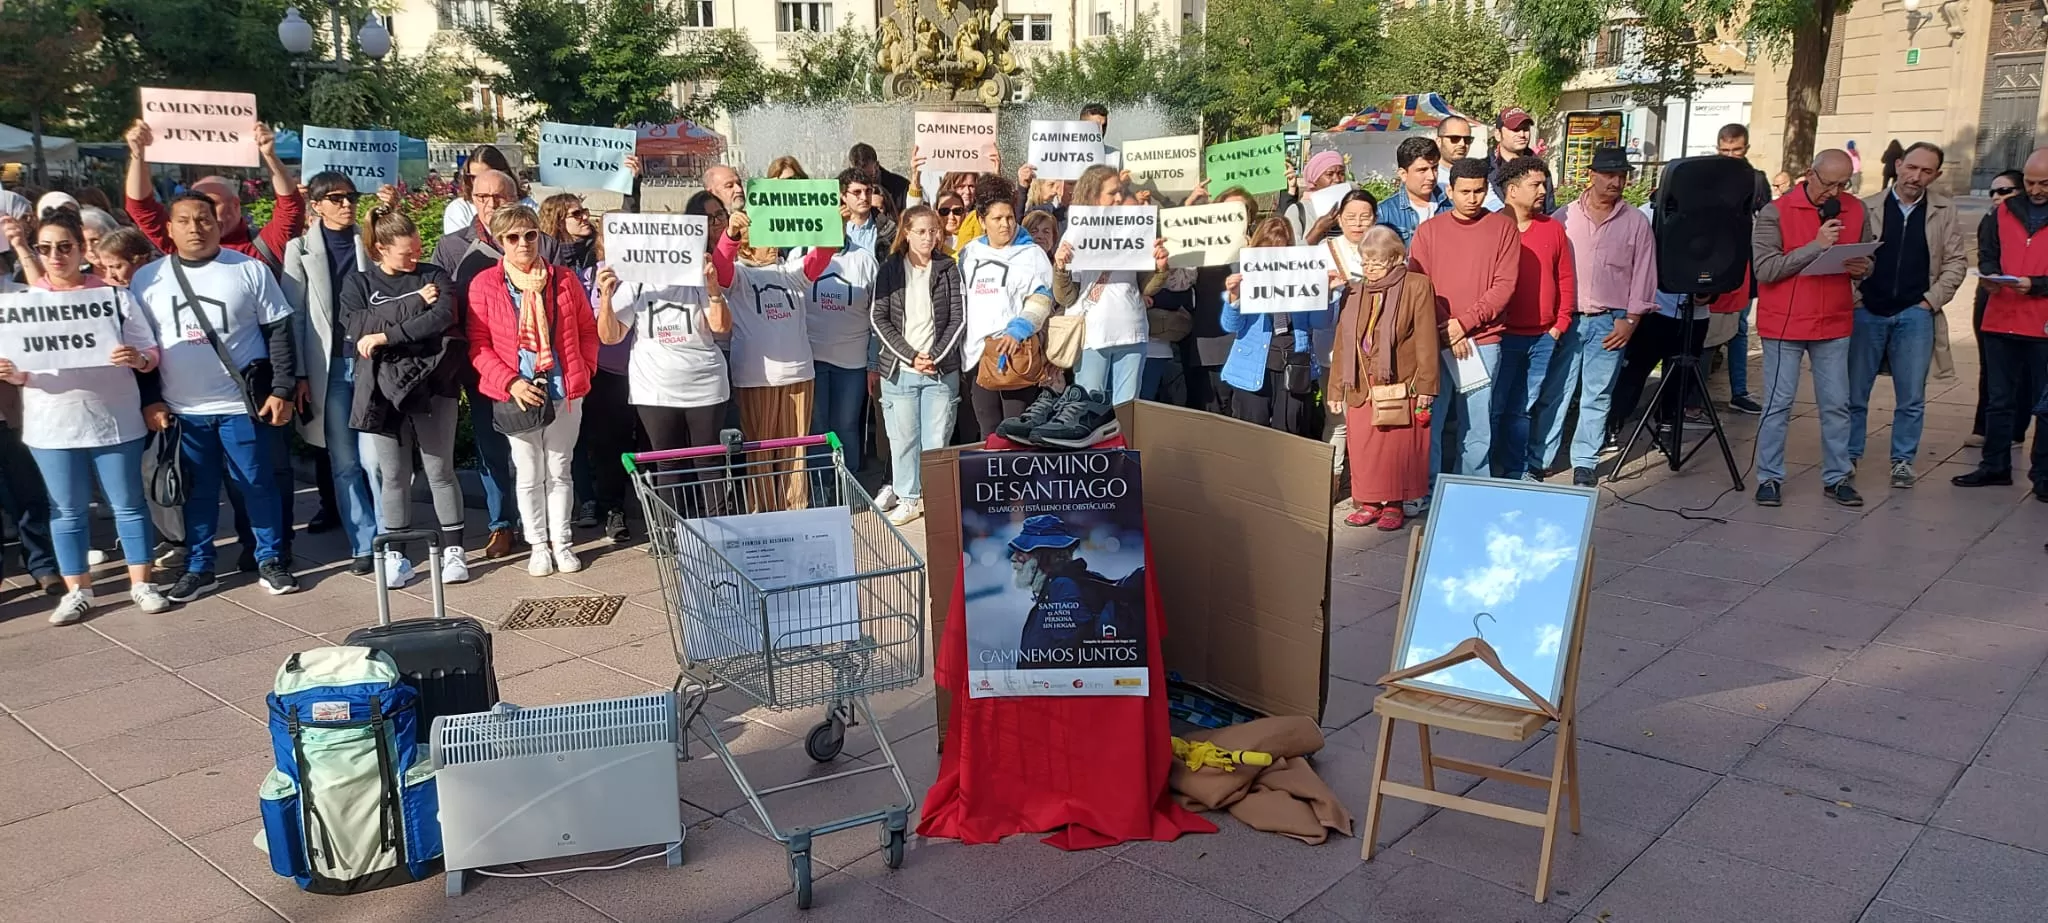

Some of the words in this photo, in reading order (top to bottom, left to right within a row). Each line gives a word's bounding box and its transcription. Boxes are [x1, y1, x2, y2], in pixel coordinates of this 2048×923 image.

[146, 101, 253, 116] CAMINEMOS
[164, 128, 239, 143] JUNTAS
[917, 123, 994, 135] CAMINEMOS
[542, 133, 633, 151] CAMINEMOS
[1032, 132, 1102, 143] CAMINEMOS
[306, 138, 398, 153] CAMINEMOS
[932, 149, 979, 160] JUNTOS
[1040, 152, 1094, 163] JUNTAS
[1126, 148, 1197, 162] CAMINEMOS
[1208, 143, 1283, 163] CAMINEMOS
[553, 157, 620, 172] JUNTOS
[1139, 168, 1184, 180] JUNTOS
[1223, 166, 1271, 181] JUNTOS
[748, 192, 838, 206] CAMINEMOS
[769, 218, 823, 232] JUNTOS
[1070, 215, 1154, 226] CAMINEMOS
[1163, 211, 1245, 228] CAMINEMOS
[608, 222, 704, 237] CAMINEMOS
[1078, 238, 1145, 250] JUNTAS
[1179, 234, 1232, 248] JUNTAS
[622, 250, 692, 264] JUNTOS
[1243, 259, 1326, 272] CAMINEMOS
[1249, 284, 1320, 299] JUNTAS
[821, 304, 845, 312] HOGAR
[767, 312, 791, 320] HOGAR
[24, 333, 96, 352] JUNTOS
[987, 457, 1008, 477] EL
[1012, 453, 1109, 476] CAMINO
[976, 482, 1005, 502] DE
[1009, 478, 1128, 501] SANTIAGO
[996, 505, 1019, 513] LARGO
[1025, 503, 1040, 512] ESTÁ
[1062, 503, 1072, 511] DE
[1072, 502, 1116, 511] OBSTÁCULOS
[1038, 602, 1080, 610] SANTIAGO
[979, 647, 1074, 665] CAMINEMOS
[1077, 646, 1138, 665] JUNTOS
